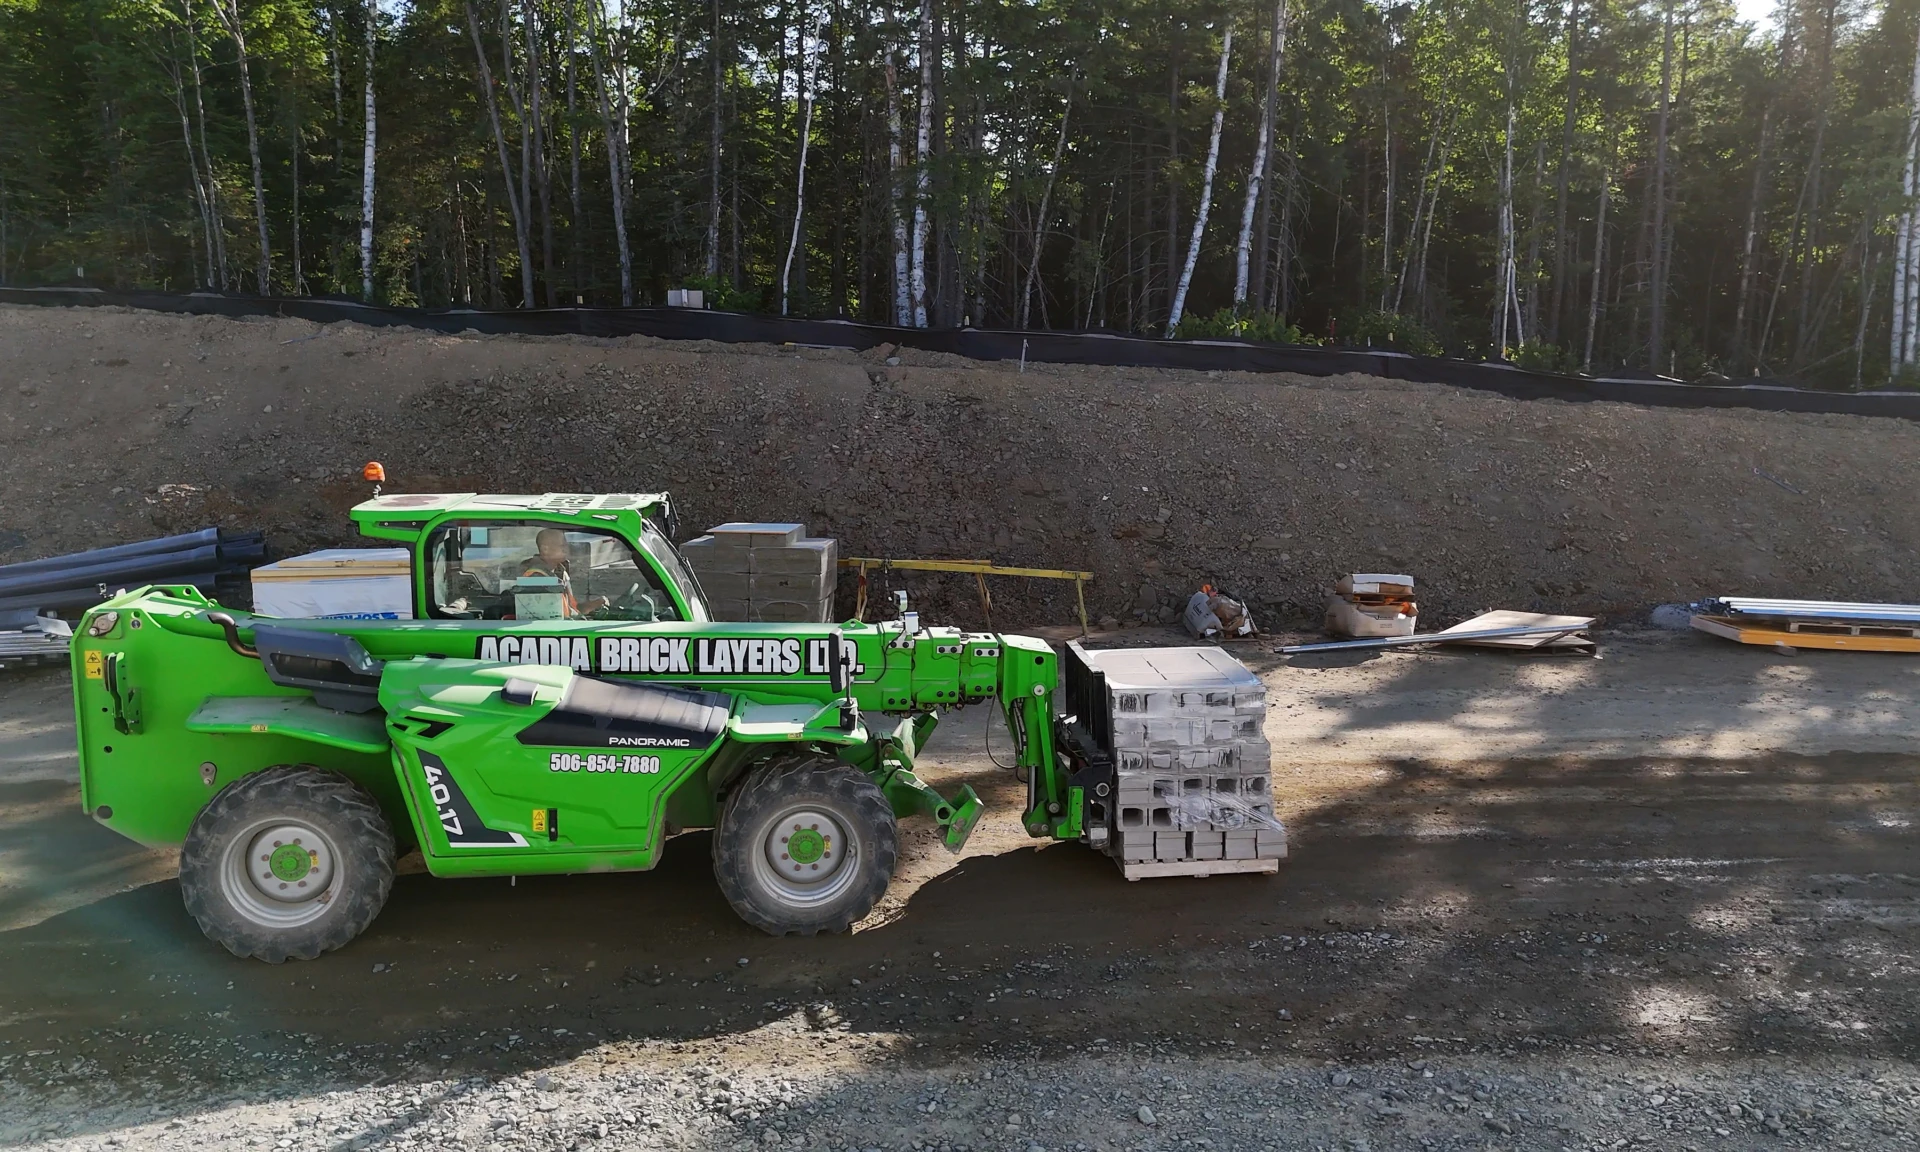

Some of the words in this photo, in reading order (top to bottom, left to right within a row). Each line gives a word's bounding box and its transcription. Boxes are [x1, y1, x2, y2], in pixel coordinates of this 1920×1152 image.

[479, 636, 591, 672] ACADIA
[600, 637, 689, 673] BRICK
[699, 638, 801, 674] LAYERS
[609, 737, 690, 747] PANORAMIC
[550, 753, 660, 774] 506-854-7880
[424, 765, 463, 836] 40.17
